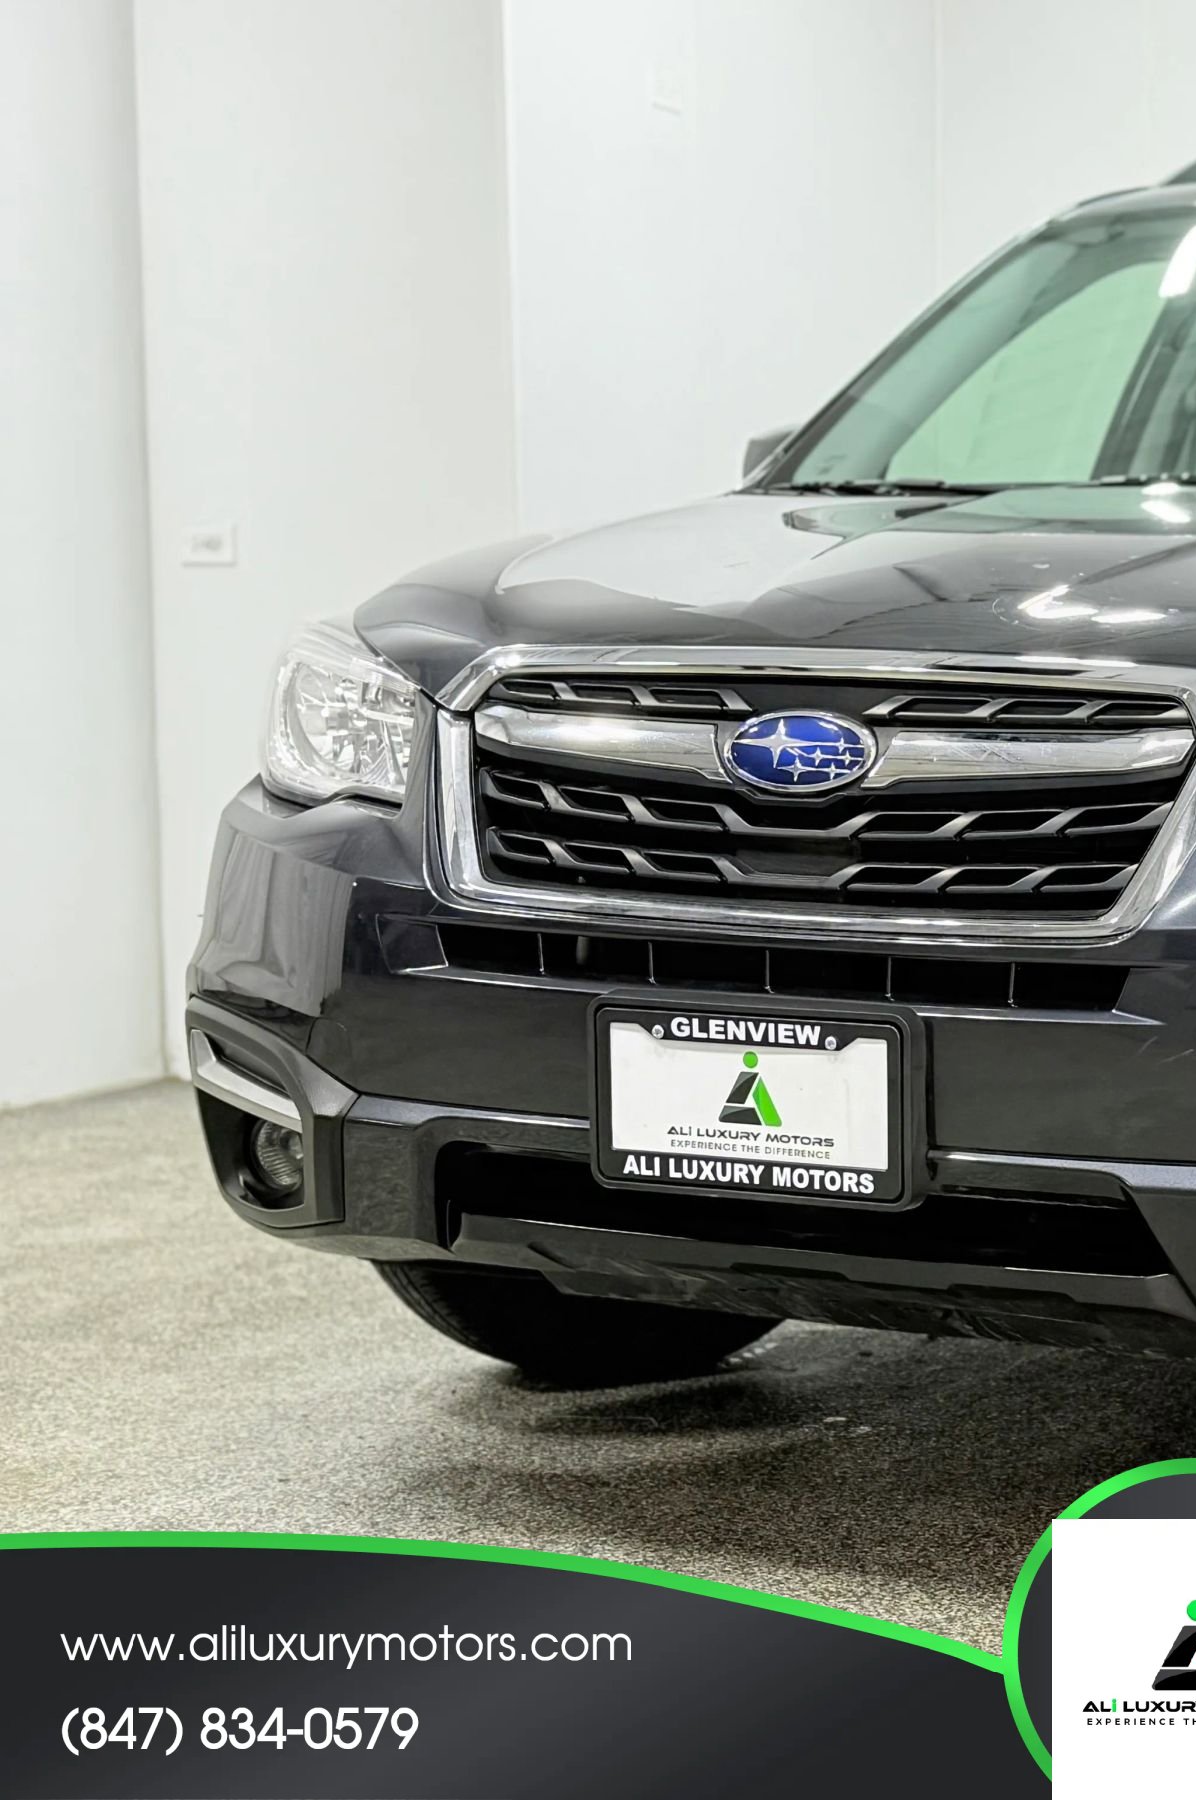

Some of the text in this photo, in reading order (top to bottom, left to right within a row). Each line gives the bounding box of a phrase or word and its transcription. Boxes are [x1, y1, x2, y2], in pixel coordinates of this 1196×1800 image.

[670, 1016, 821, 1046] GLENVIEW
[670, 1139, 831, 1160] EXPERIENCE THE DIFFERENCE
[696, 1127, 761, 1142] LUXURY
[765, 1132, 835, 1148] MOTORS
[623, 1154, 875, 1194] ALI LUXURY MOTORS
